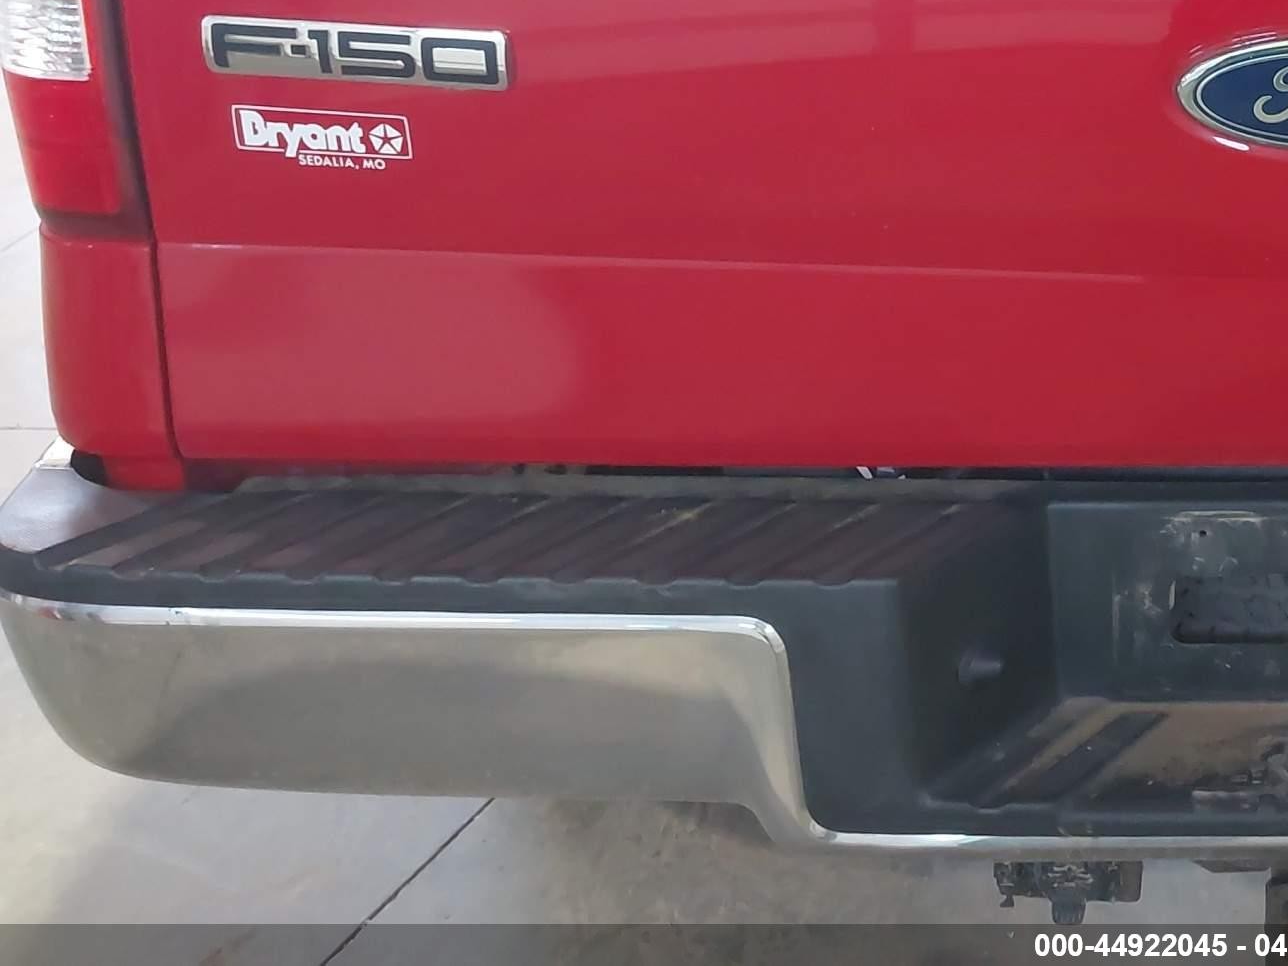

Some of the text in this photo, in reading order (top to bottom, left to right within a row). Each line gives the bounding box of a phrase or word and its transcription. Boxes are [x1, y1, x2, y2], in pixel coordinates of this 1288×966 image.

[237, 108, 367, 158] Bryant
[297, 153, 387, 170] SEDALIA, MO
